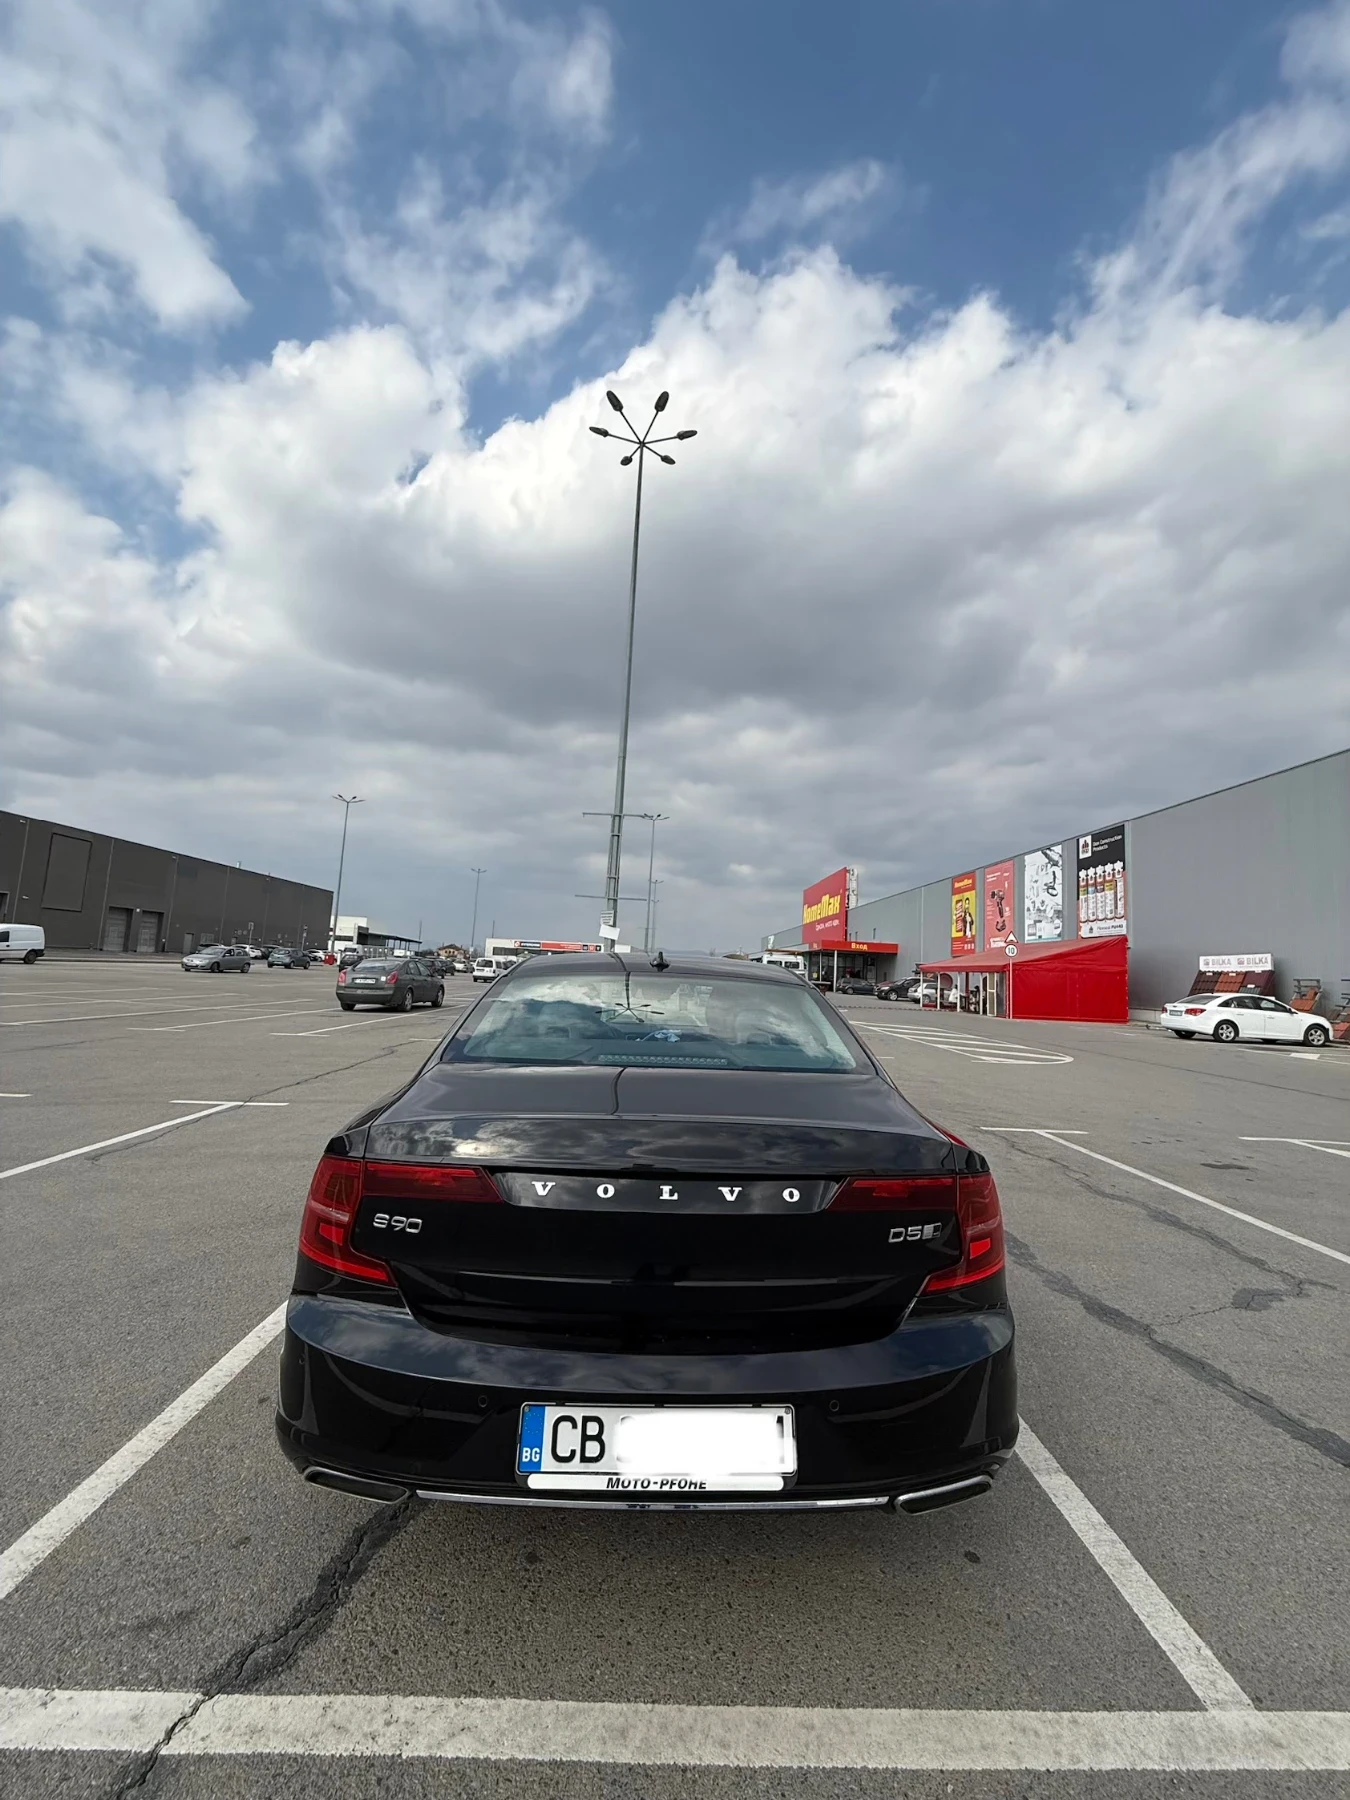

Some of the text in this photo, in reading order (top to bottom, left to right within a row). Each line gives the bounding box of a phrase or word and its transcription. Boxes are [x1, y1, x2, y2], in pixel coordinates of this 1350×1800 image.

[803, 893, 841, 925] HomeMax
[851, 942, 868, 951] Вход
[1008, 947, 1015, 955] 10
[1211, 958, 1232, 966] BILKA
[1246, 956, 1269, 965] BILKA
[531, 1181, 801, 1203] VOLVO
[372, 1213, 423, 1234] S90
[550, 1413, 606, 1464] CB
[522, 1447, 541, 1463] BG
